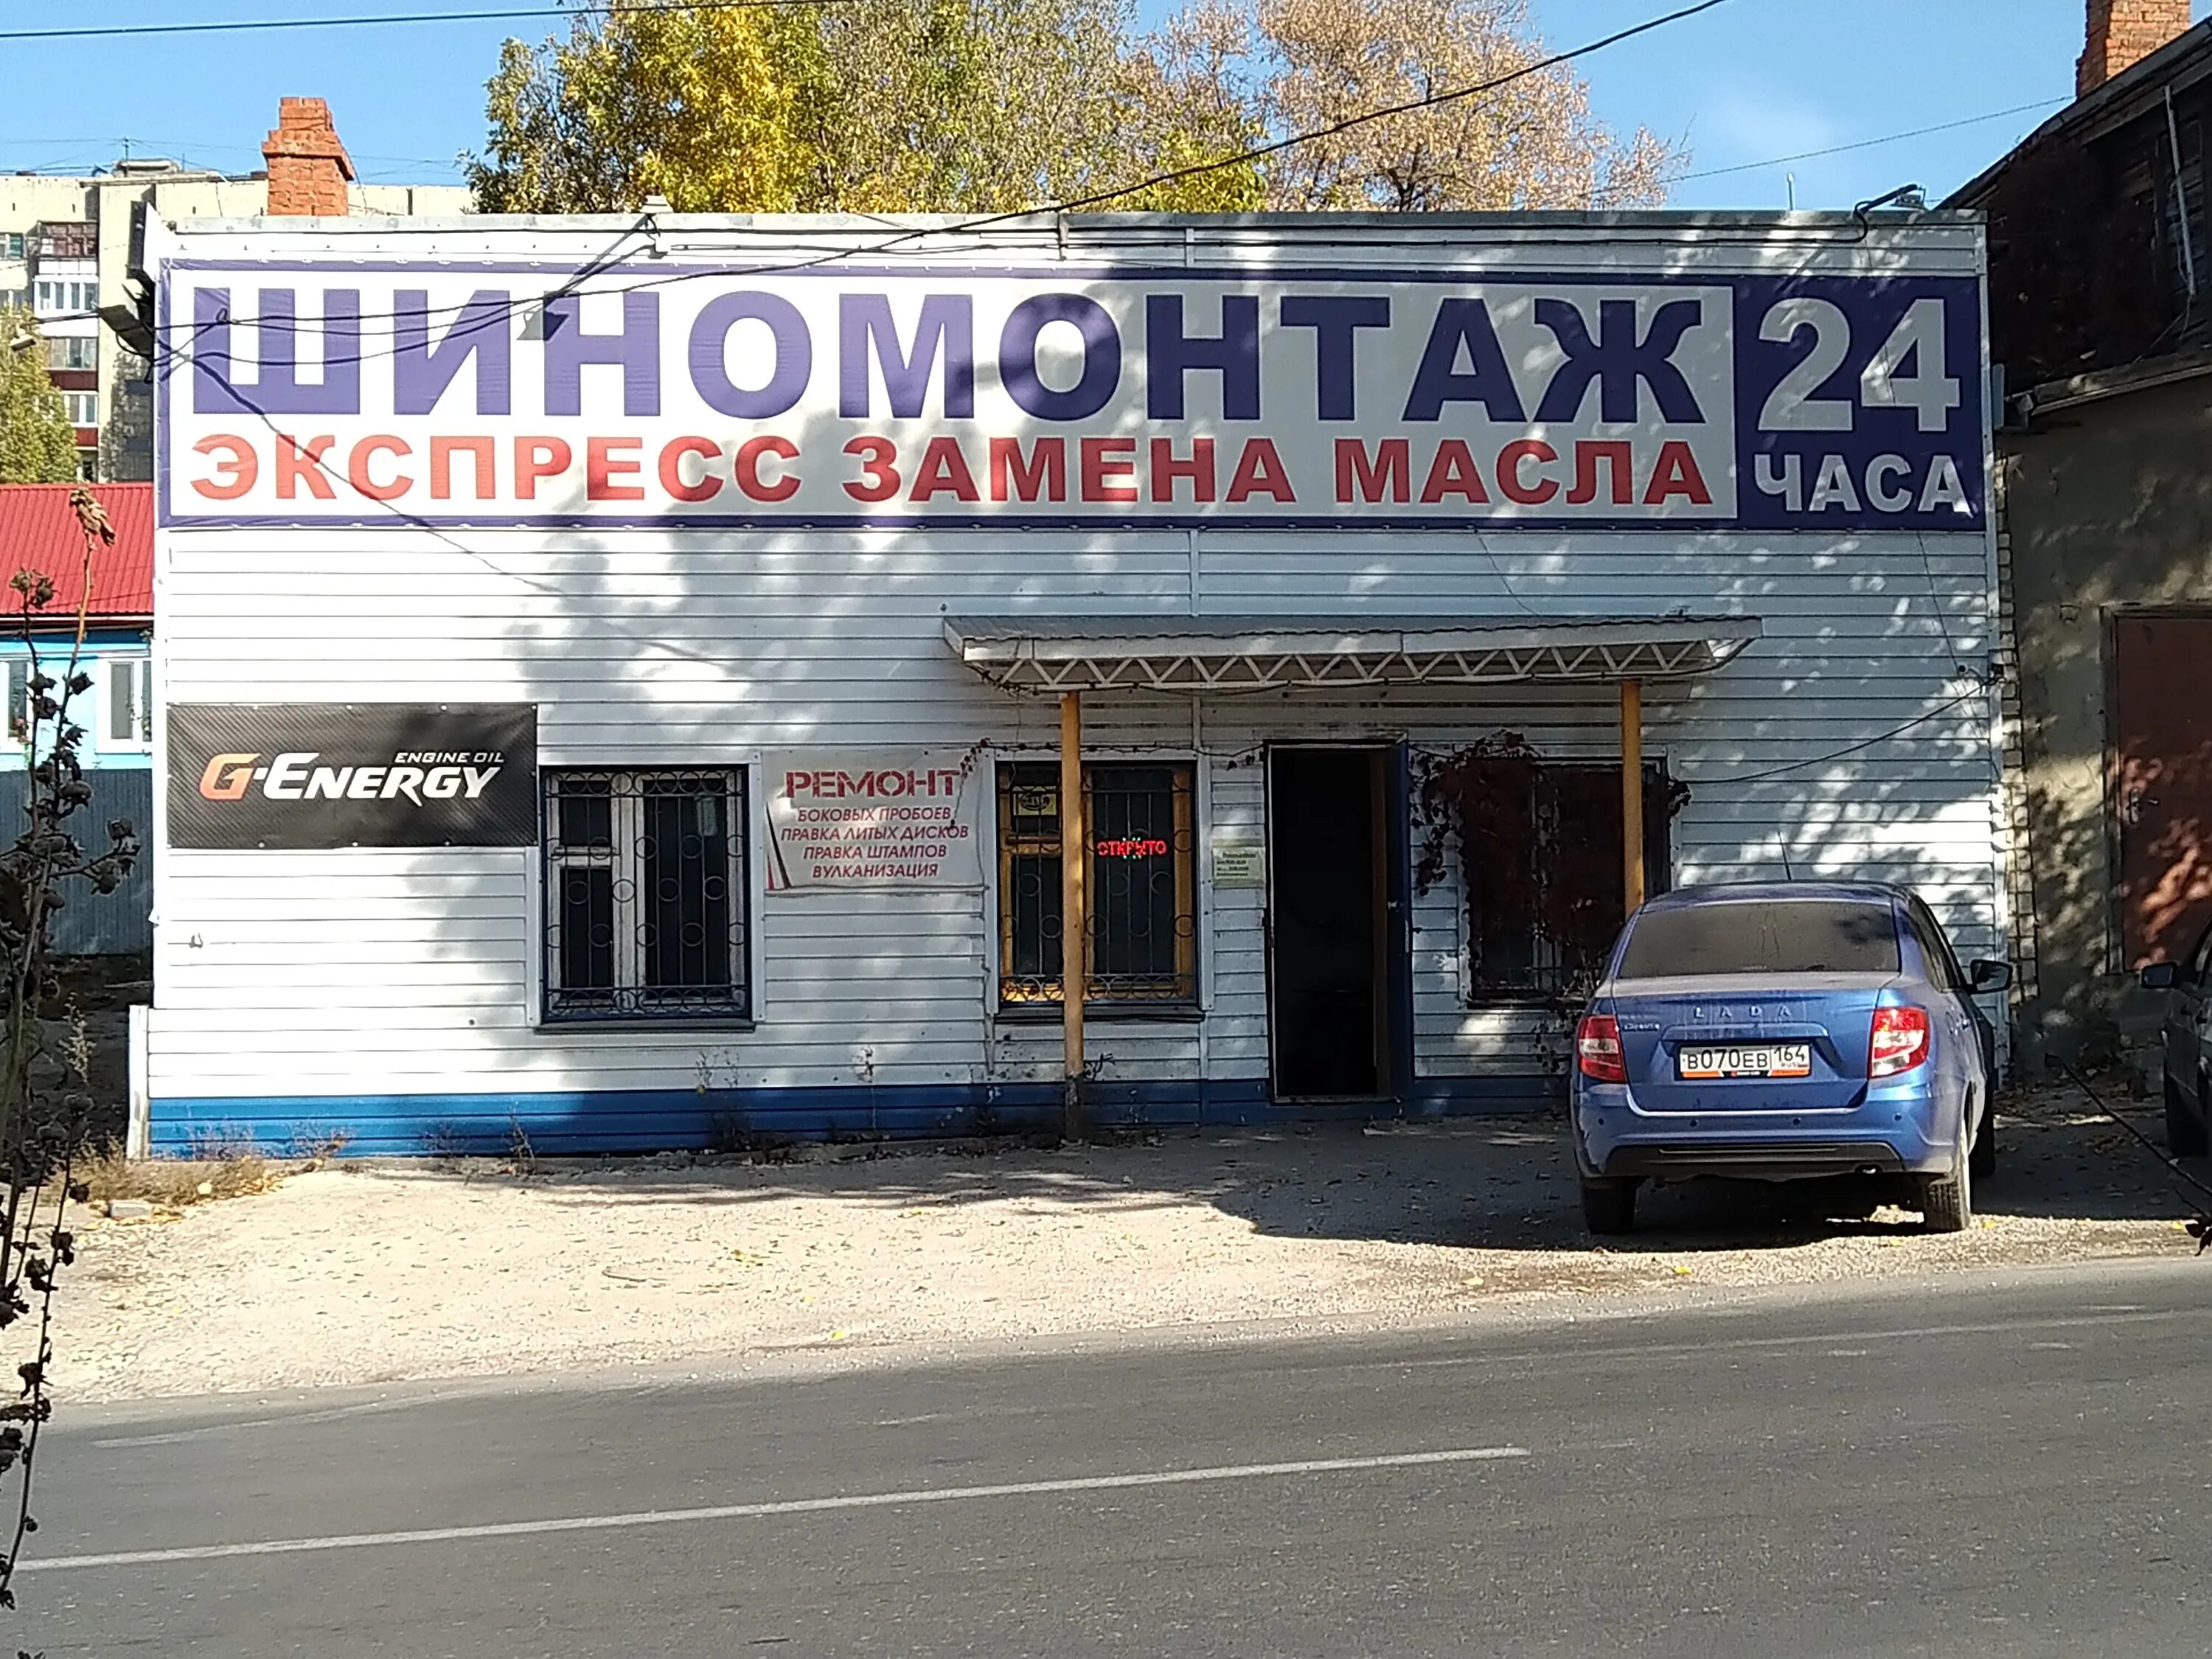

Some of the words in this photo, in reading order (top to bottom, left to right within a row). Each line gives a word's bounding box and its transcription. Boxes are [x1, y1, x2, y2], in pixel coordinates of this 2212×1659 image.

[192, 286, 1706, 423] ШИНОМОНТАЖ
[1758, 297, 1961, 433] 24
[190, 434, 801, 503] ЭКСПРЕСС
[842, 436, 1296, 504] ЗАМЕНА
[1335, 439, 1713, 506] МАСЛА
[1754, 454, 1977, 512] ЧАСА
[394, 752, 471, 764] ENGINE
[473, 752, 505, 763] OIL
[785, 770, 961, 798] РЕМОНТ
[798, 808, 875, 822] БОКОВЫХ
[879, 807, 950, 821] ПРОБОЕВ
[781, 827, 841, 841] ПРАВКА
[843, 826, 898, 841] ЛИТЫХ
[900, 825, 969, 841] ДИСКОВ
[803, 846, 863, 860] ПРАВКА
[867, 845, 947, 859] ШТАМПОВ
[1096, 841, 1167, 855] ОТКРЫТО
[813, 863, 939, 879] ВУЛКАНИЗАЦИЯ
[1694, 1005, 1790, 1018] LADA
[1773, 1046, 1806, 1062] 164
